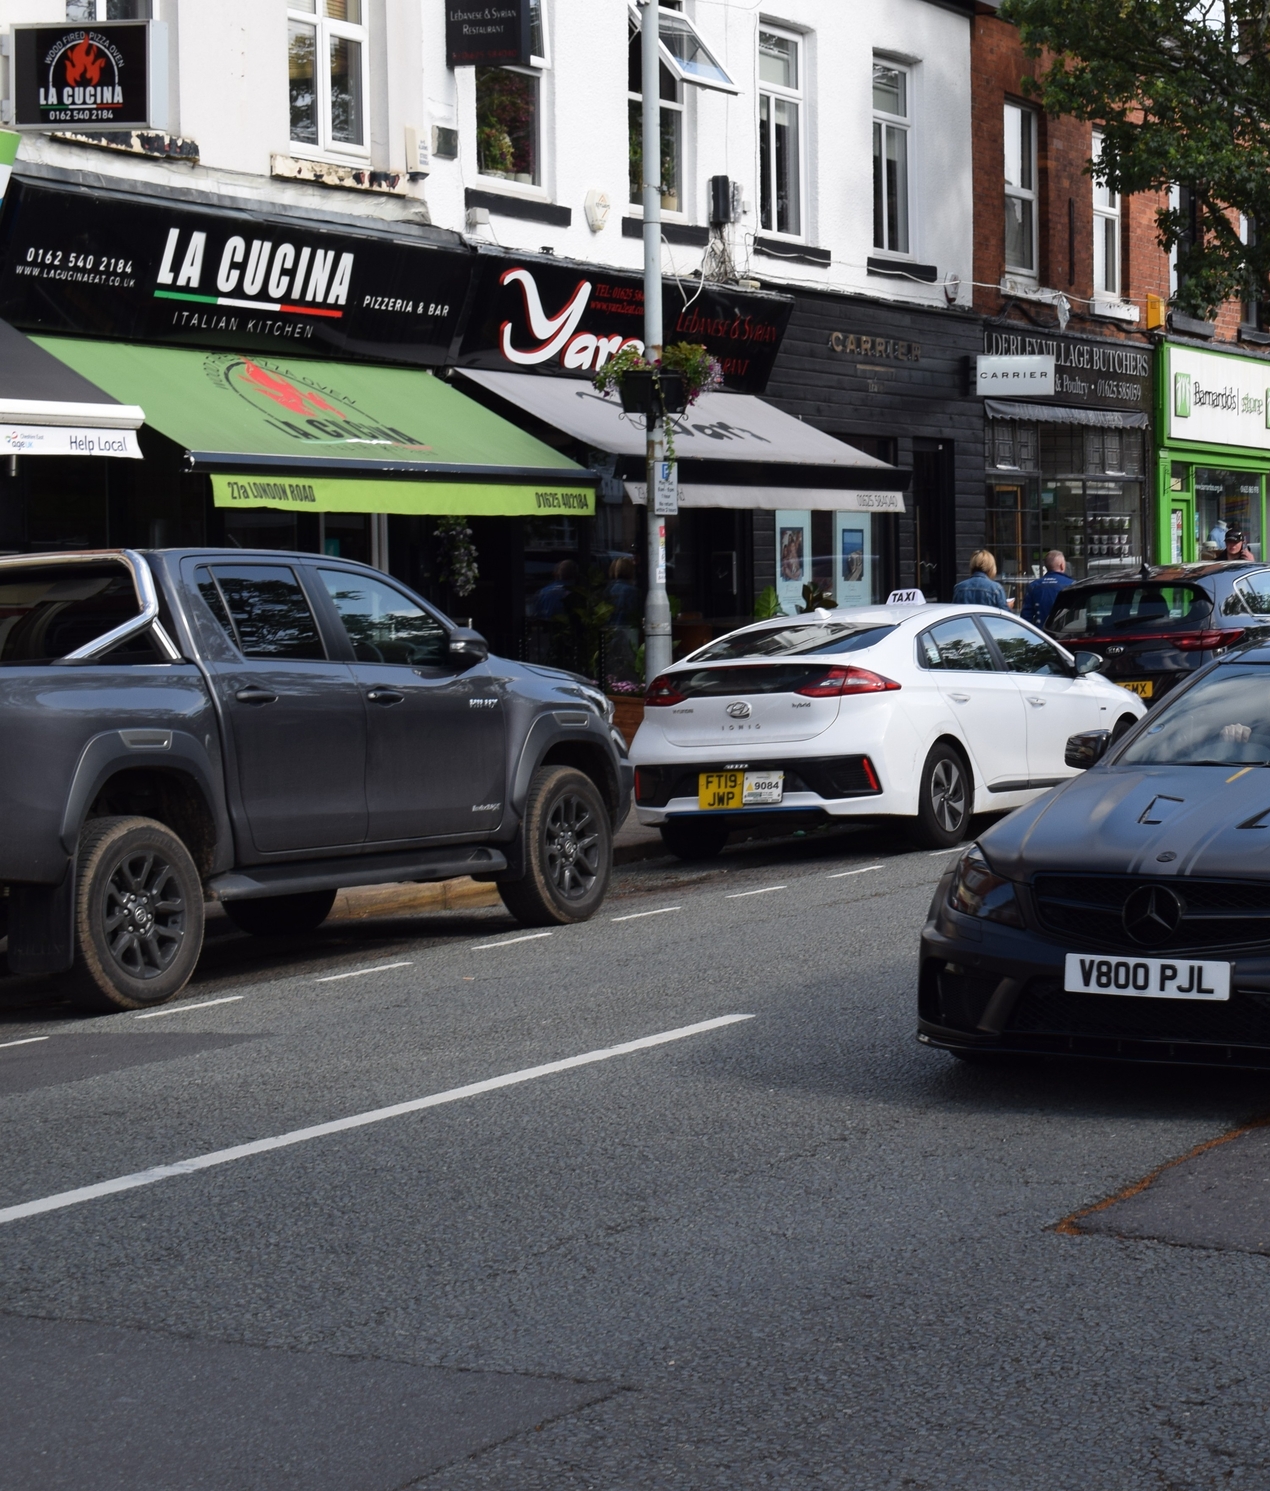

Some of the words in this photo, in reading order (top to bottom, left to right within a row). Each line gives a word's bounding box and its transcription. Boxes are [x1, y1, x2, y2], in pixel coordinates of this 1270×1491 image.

[484, 9, 491, 19] &
[462, 24, 504, 35] RESTAURANT
[44, 42, 63, 64] WOOD
[63, 31, 85, 45] FIRED
[89, 31, 109, 48] PIZZA
[110, 45, 125, 68] OVEN
[40, 87, 58, 105] LA
[63, 86, 123, 105] CUCINA
[50, 111, 71, 120] 0162
[73, 110, 90, 120] 540
[91, 110, 114, 119] 2184
[26, 247, 63, 265] 0162
[68, 253, 94, 269] 540
[99, 257, 133, 274] 2184
[156, 228, 207, 287] LA
[216, 236, 354, 305] CUCINA
[15, 265, 136, 287] WWW.LACUCINAEAT.CO.UK
[612, 287, 633, 300] 01625
[363, 295, 412, 313] PIZZERIA
[417, 304, 424, 314] &
[427, 304, 450, 317] BAR
[172, 311, 239, 331] ITALIAN
[247, 319, 314, 339] KITCHEN
[730, 314, 740, 338] &
[831, 331, 921, 362] CARRIER
[984, 331, 1042, 356] LDERLEY
[1093, 348, 1149, 377] BUTCHERS
[980, 371, 1048, 379] CARRIER
[302, 376, 357, 405] OVEN
[1063, 376, 1089, 399] Poultry
[1097, 379, 1117, 399] 01625
[1193, 381, 1236, 410] Barnardo's
[1241, 393, 1263, 416] store
[263, 419, 321, 440] LA
[305, 418, 425, 446] CUCINA
[69, 435, 94, 455] Help
[98, 437, 128, 452] Local
[228, 481, 249, 500] 27a
[250, 482, 288, 501] LONDON
[289, 484, 316, 503] ROAD
[535, 492, 561, 509] 01625
[561, 493, 589, 510] 402184
[892, 591, 916, 603] TAXI
[706, 774, 737, 789] FT19
[754, 782, 779, 790] 9084
[708, 791, 735, 806] JWP
[1079, 958, 1149, 991] V800
[1159, 963, 1214, 994] PJL
